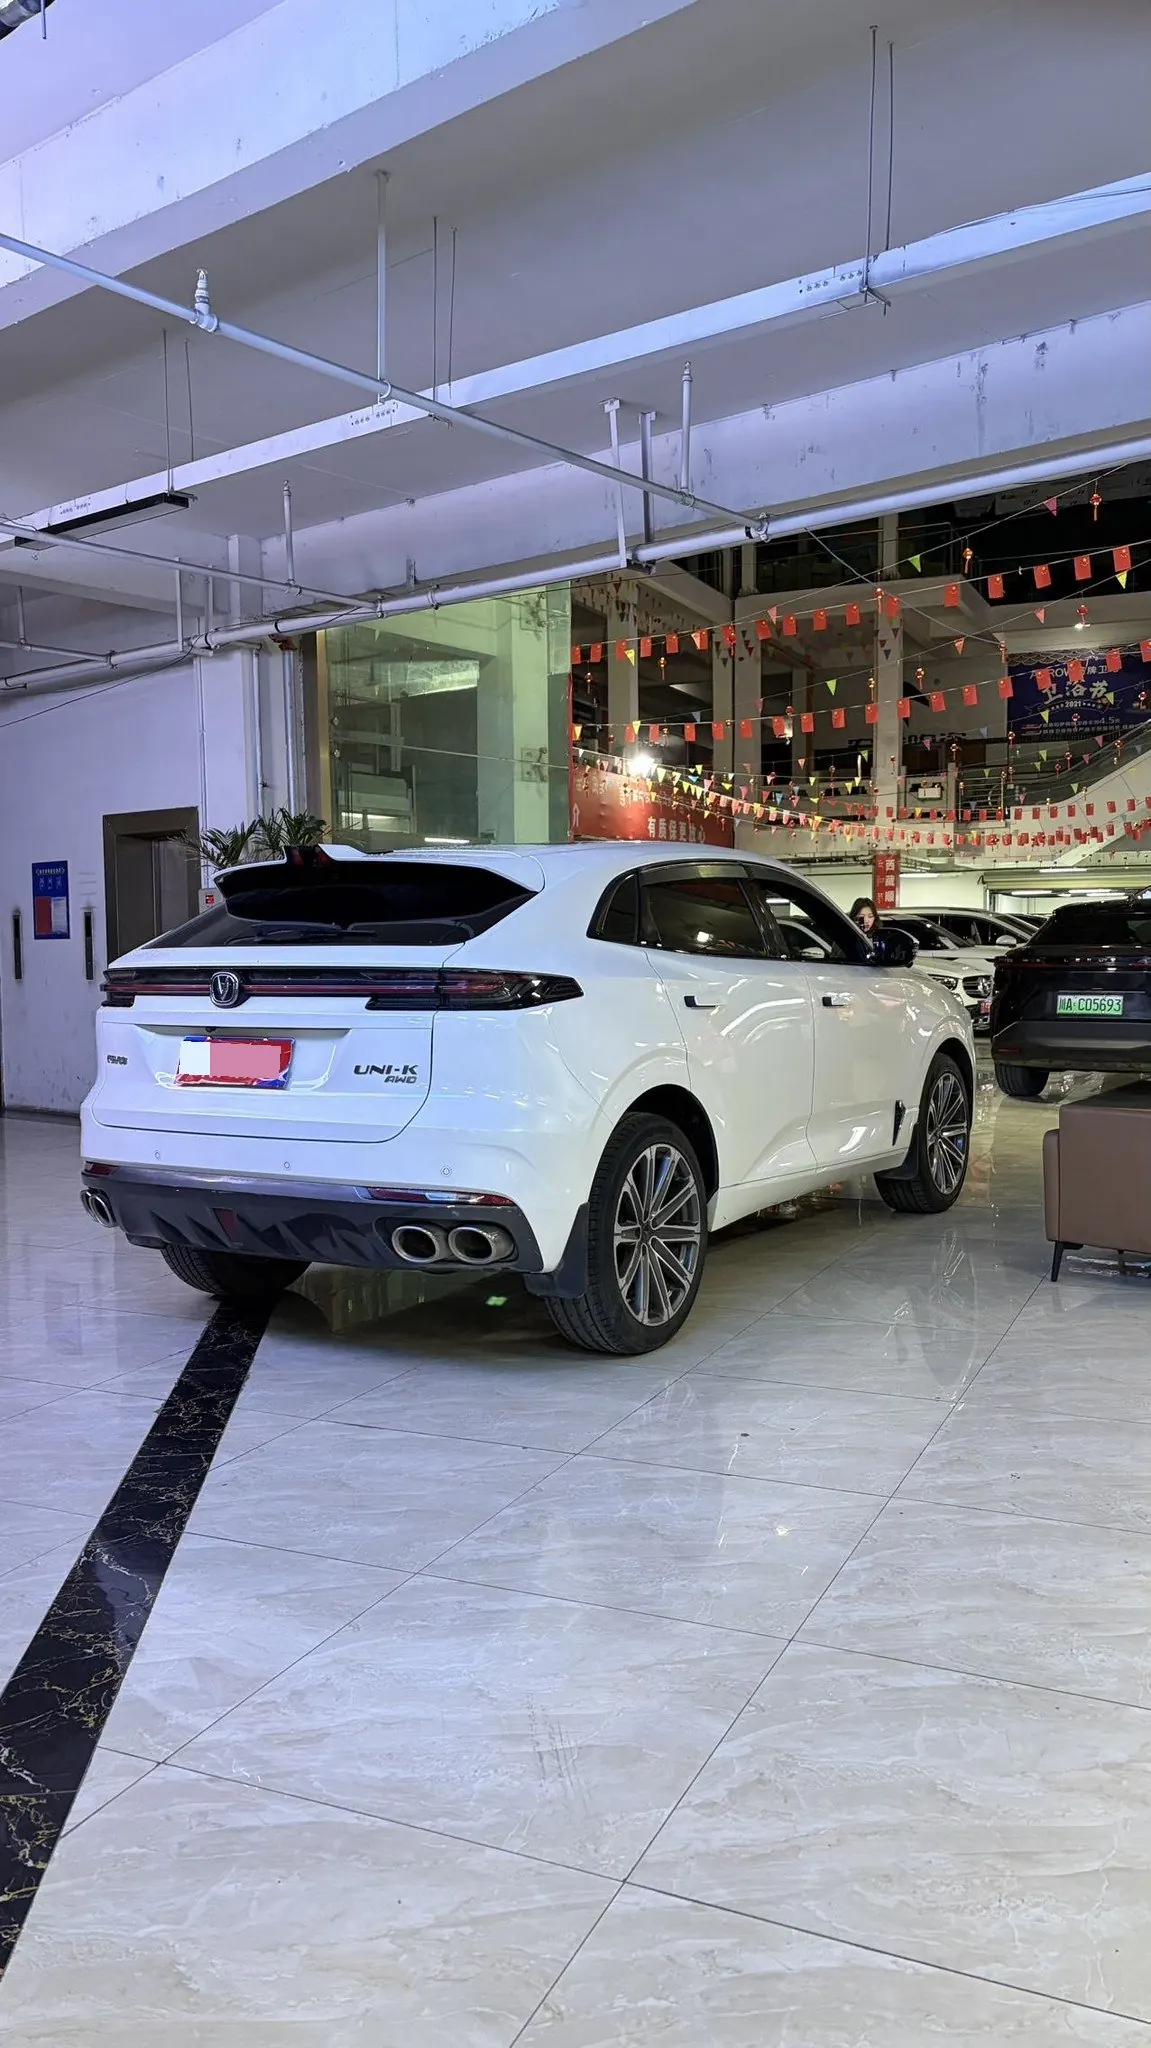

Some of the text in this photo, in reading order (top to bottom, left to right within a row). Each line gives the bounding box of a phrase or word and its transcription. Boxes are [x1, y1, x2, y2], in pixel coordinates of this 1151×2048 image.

[1042, 680, 1109, 704] 卫浴节
[354, 1065, 419, 1075] UNI-K
[384, 1075, 417, 1084] AWD
